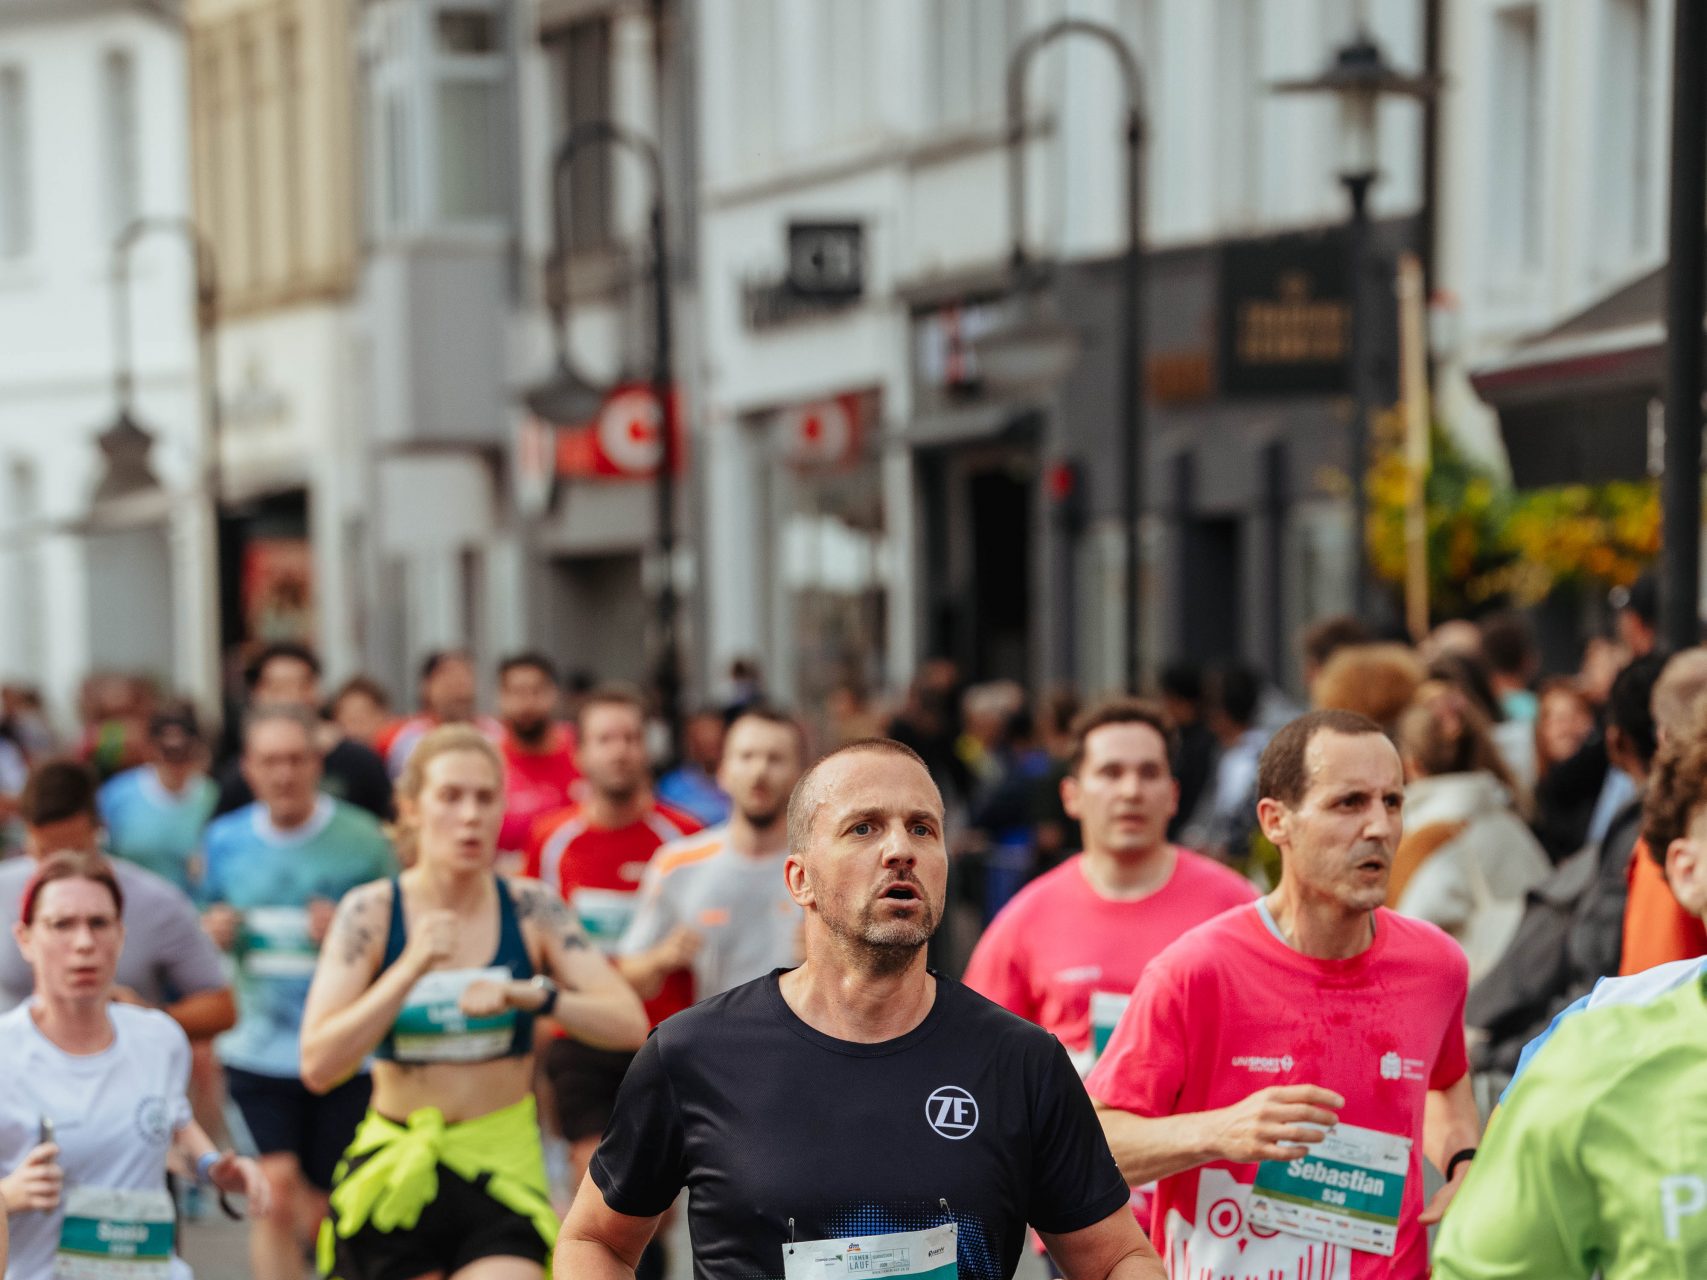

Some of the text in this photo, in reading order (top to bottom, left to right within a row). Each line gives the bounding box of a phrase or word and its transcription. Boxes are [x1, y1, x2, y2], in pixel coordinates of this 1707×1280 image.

[928, 1095, 977, 1130] ZF
[1287, 1157, 1385, 1197] Sebastian
[849, 1261, 870, 1270] LAUF
